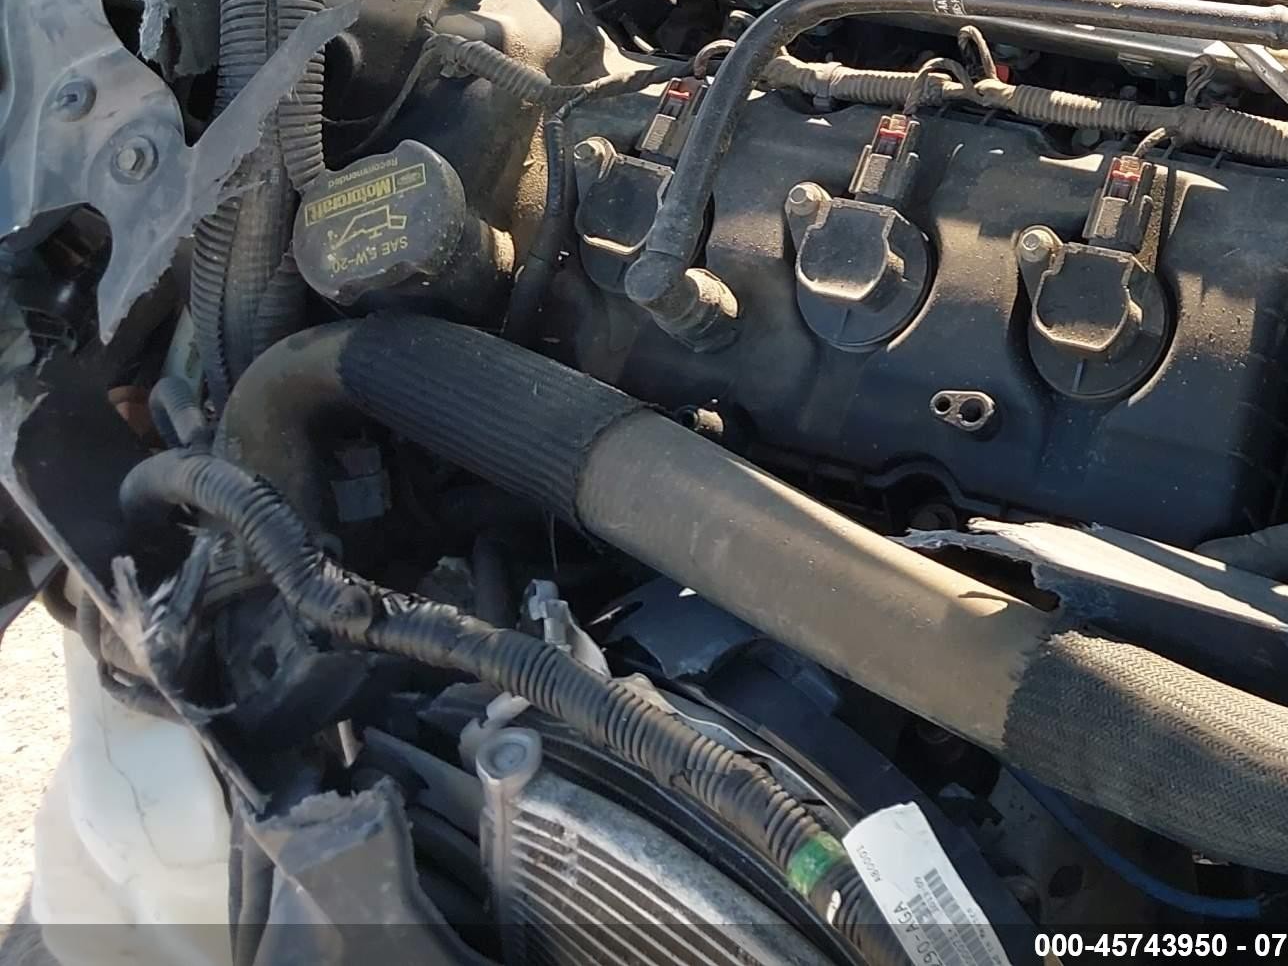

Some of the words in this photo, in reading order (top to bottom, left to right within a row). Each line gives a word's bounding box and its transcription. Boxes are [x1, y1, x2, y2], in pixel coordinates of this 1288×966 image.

[328, 157, 398, 188] Recommended
[307, 177, 391, 222] Motorcraft
[382, 236, 408, 252] SAE
